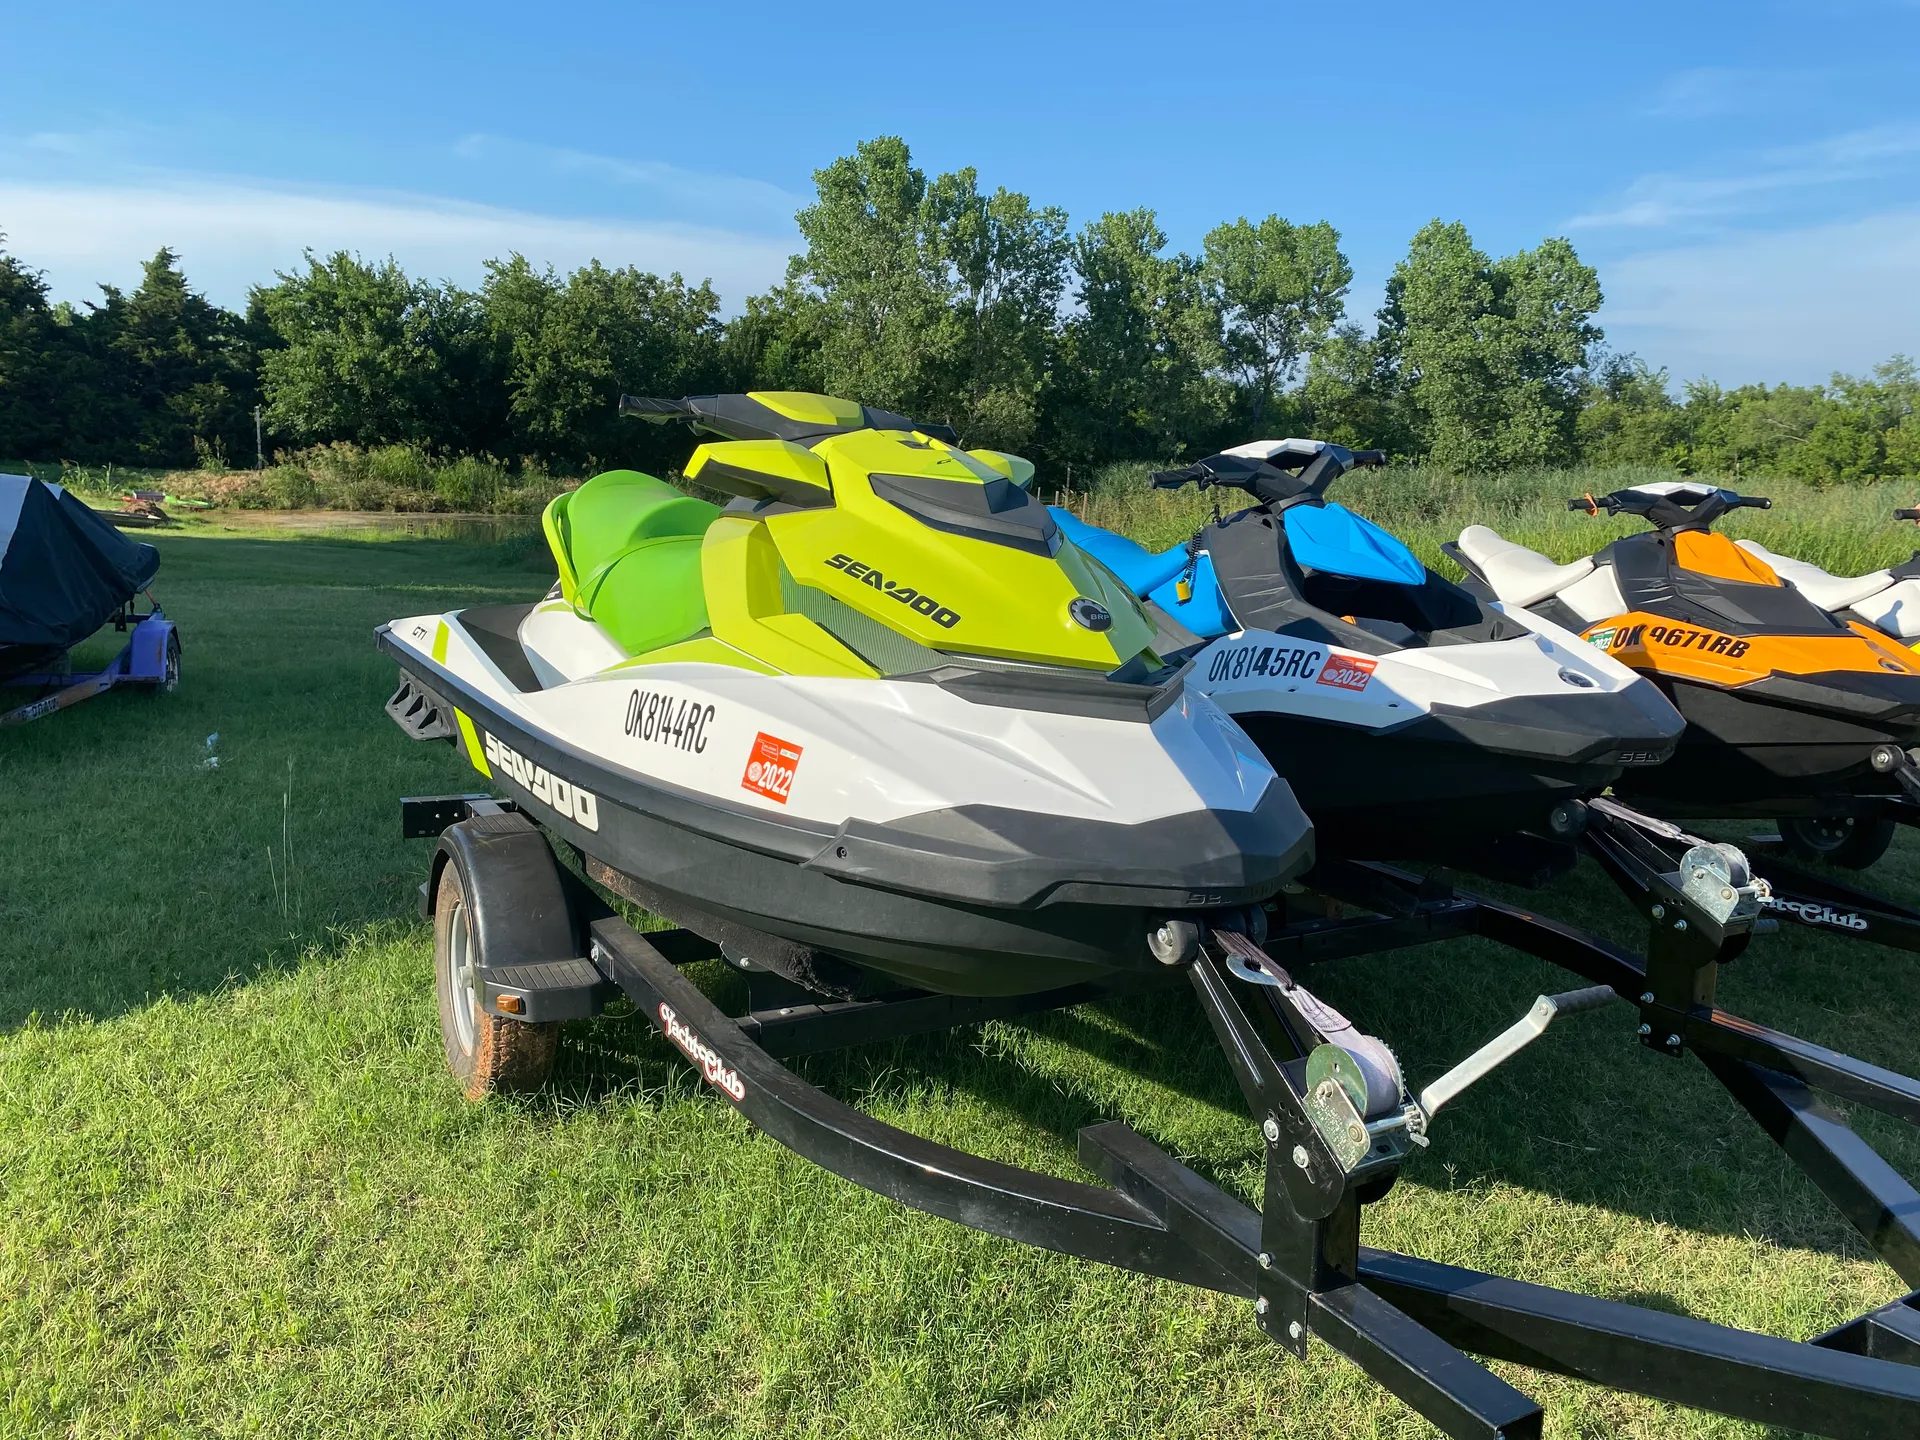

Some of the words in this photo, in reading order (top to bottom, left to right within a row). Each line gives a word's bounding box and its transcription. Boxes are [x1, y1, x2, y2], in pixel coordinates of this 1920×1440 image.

[411, 625, 428, 641] GTI
[1613, 624, 1648, 648] OK
[1649, 626, 1751, 659] 9671RB
[1208, 645, 1321, 682] OK8145RC
[1334, 668, 1370, 688] 2022
[624, 688, 716, 754] OK8144RC
[757, 761, 793, 797] 2022
